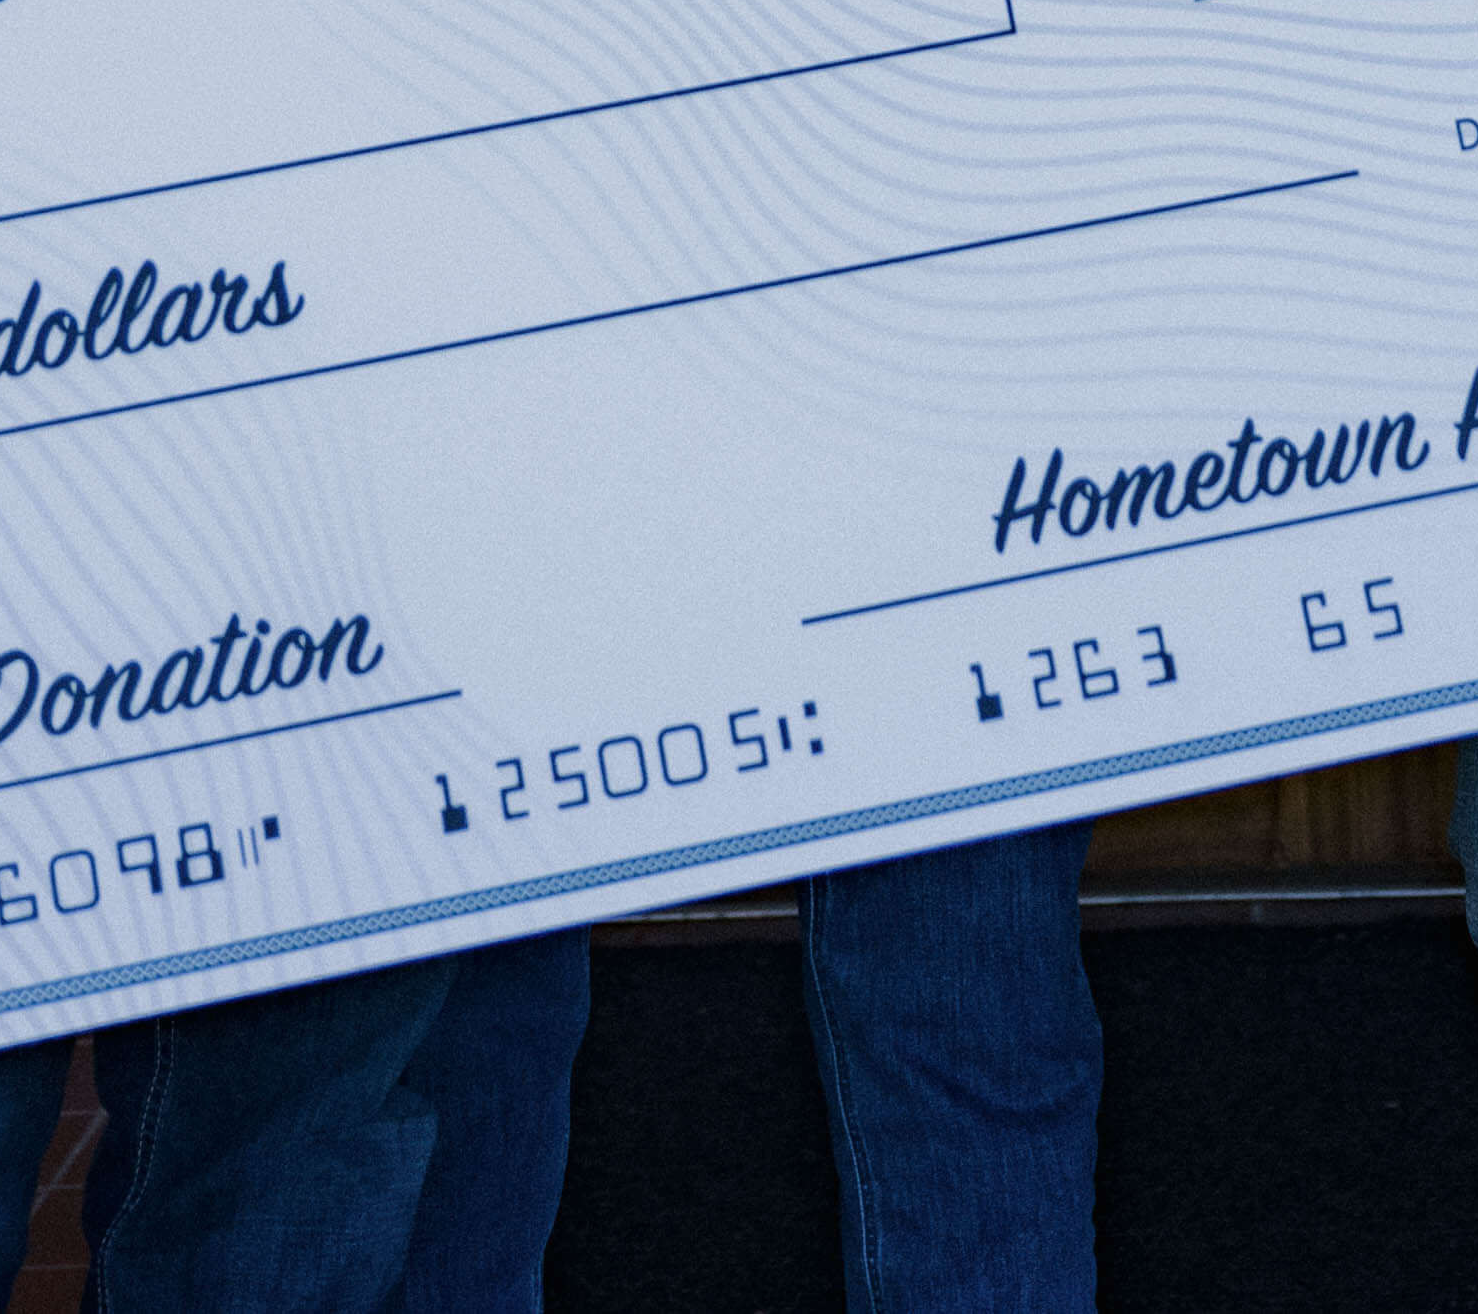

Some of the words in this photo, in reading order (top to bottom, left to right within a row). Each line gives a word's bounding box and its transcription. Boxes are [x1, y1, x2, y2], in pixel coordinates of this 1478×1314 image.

[990, 416, 1432, 556] Hometown
[967, 623, 1180, 725] 1263
[1298, 575, 1406, 655] 65
